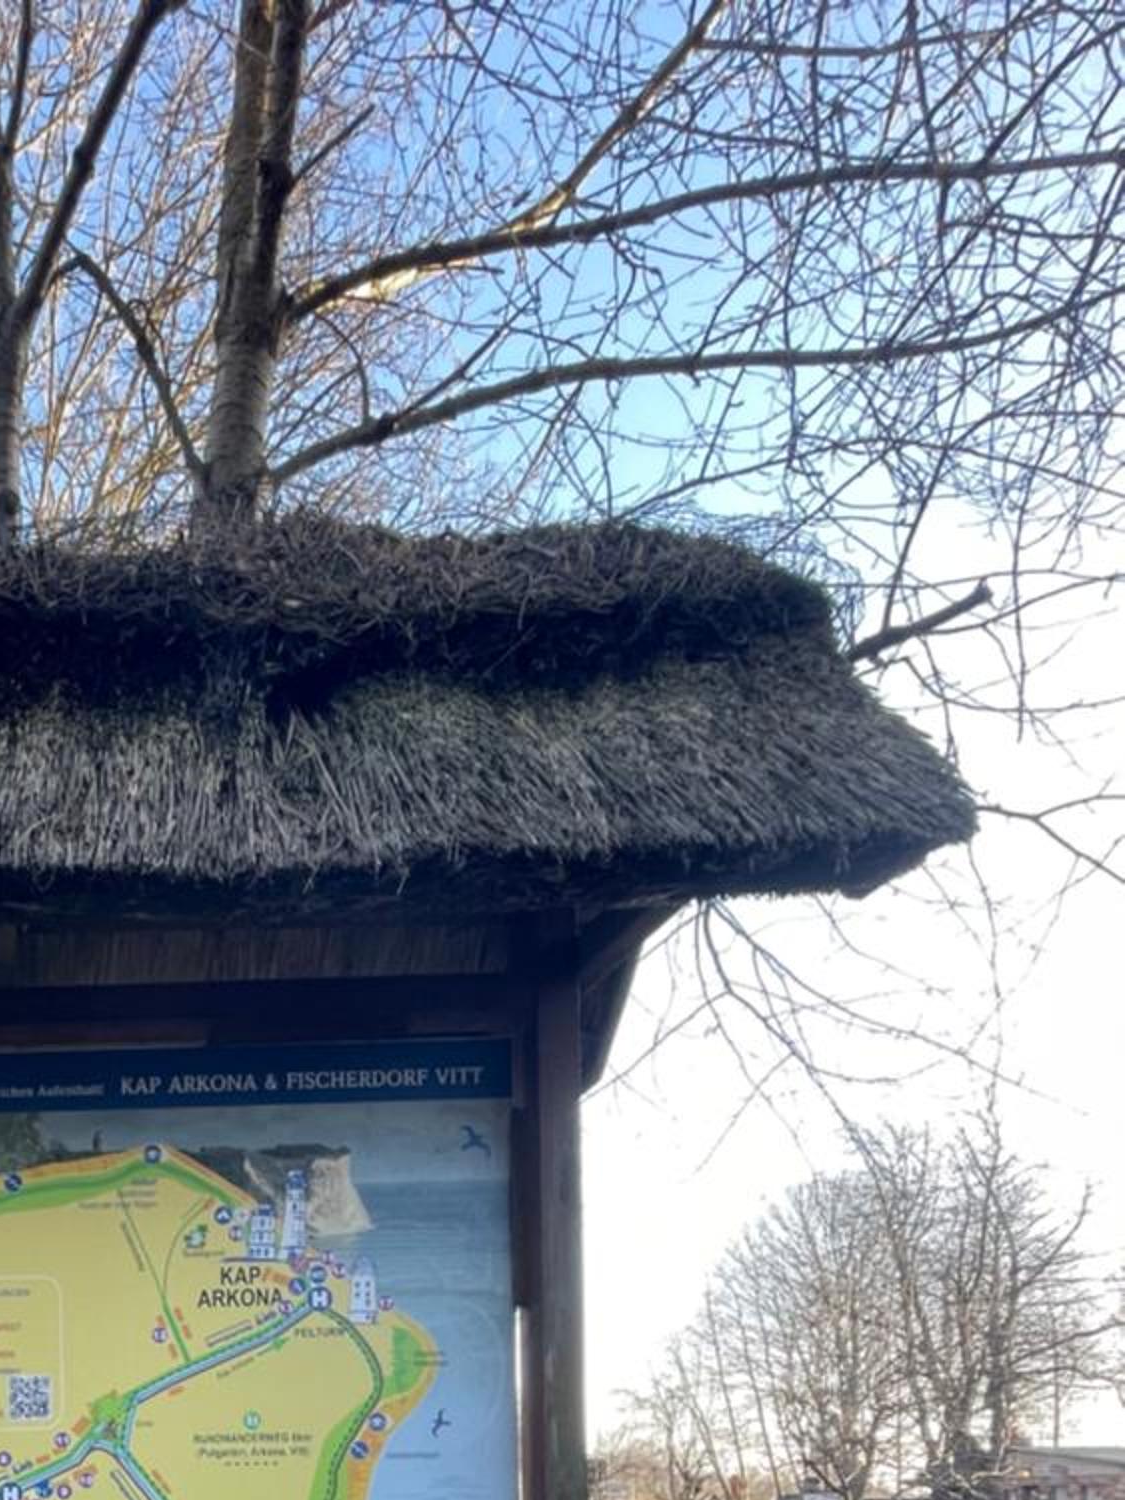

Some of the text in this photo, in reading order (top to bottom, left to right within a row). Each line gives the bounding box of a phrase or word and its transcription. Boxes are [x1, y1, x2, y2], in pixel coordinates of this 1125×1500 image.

[120, 1065, 485, 1096] KAP ARKONA & FISCHERDORF VITT
[220, 1266, 260, 1285] KAP
[198, 1289, 283, 1308] ARKONA
